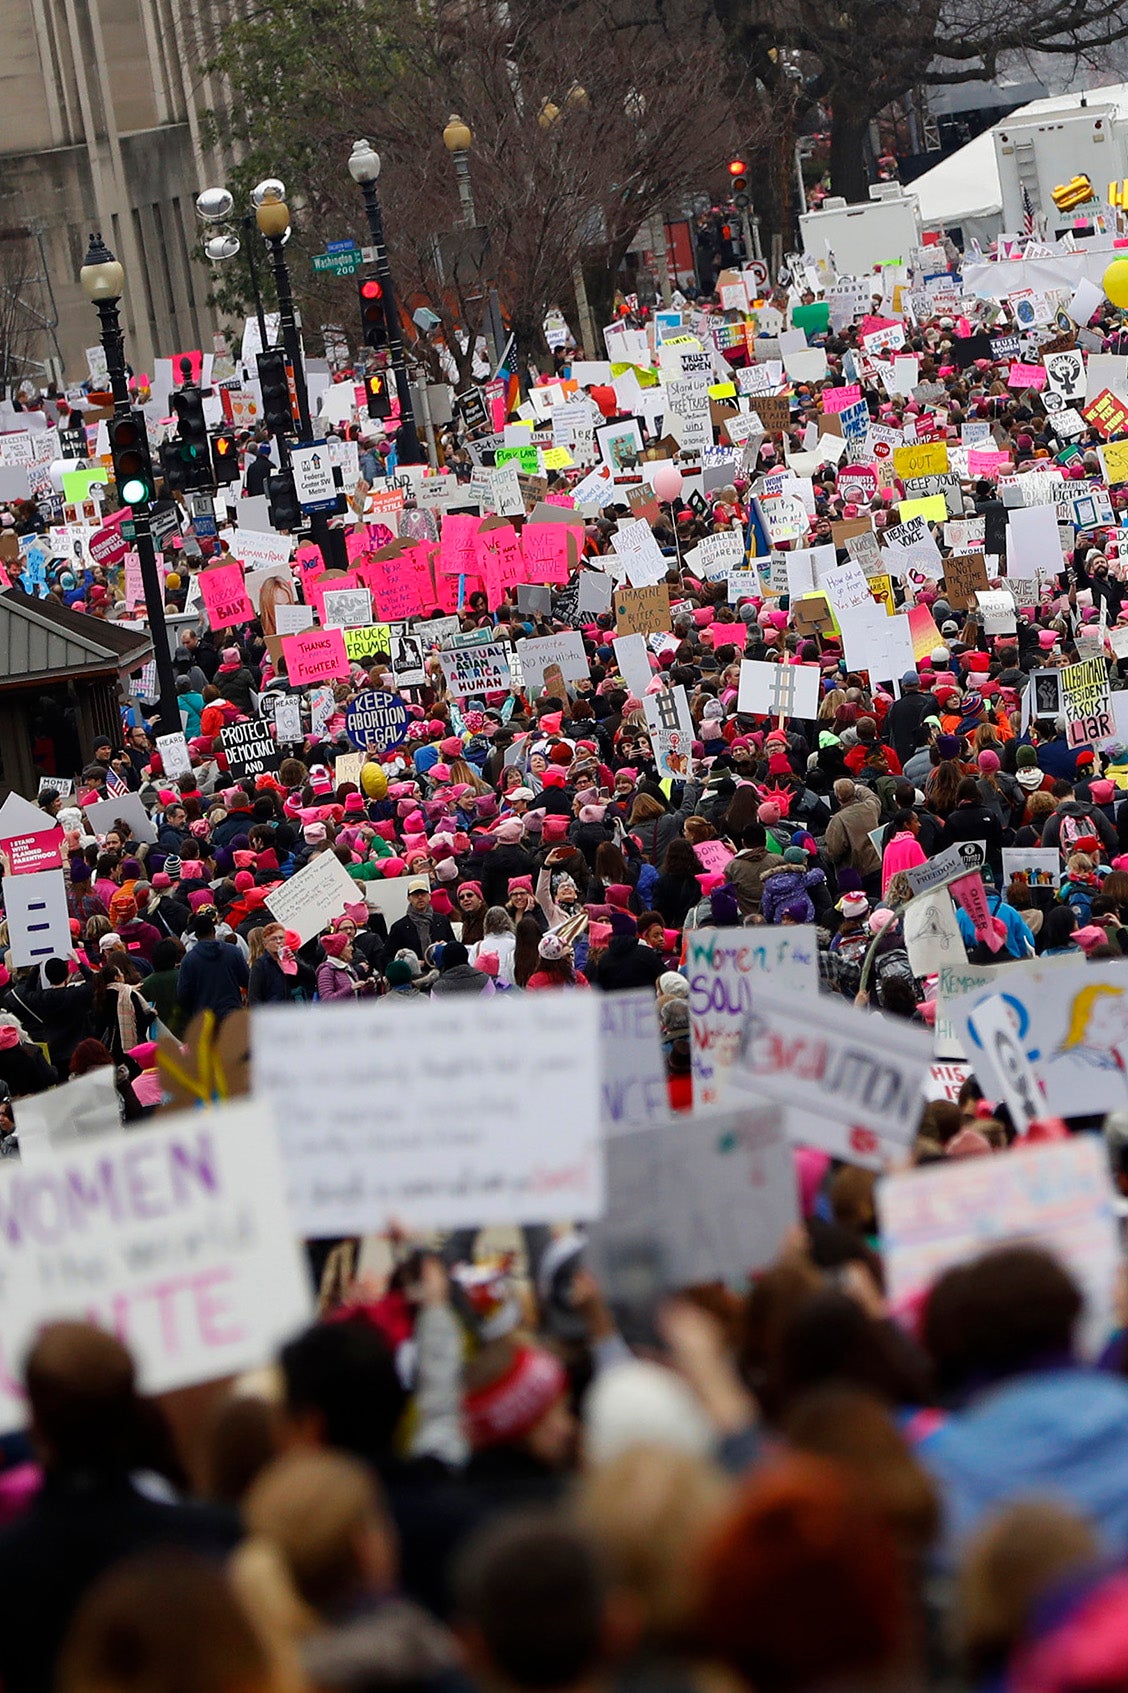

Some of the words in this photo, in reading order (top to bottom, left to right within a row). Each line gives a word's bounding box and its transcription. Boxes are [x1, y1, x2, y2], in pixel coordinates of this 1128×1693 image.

[314, 254, 353, 268] Washington
[337, 266, 354, 275] 200
[681, 353, 710, 363] TRUST
[682, 362, 712, 372] WOMEN
[670, 381, 692, 395] Stand
[870, 422, 892, 435] PROVE
[871, 433, 896, 444] WRONG
[875, 445, 890, 454] STOP
[909, 455, 933, 470] OUT
[491, 469, 516, 485] HOPE
[905, 478, 931, 491] KEEP
[935, 474, 960, 487] YOUR
[383, 503, 402, 512] STILL
[886, 523, 906, 542] HEAR
[906, 515, 925, 534] OUR
[92, 533, 119, 553] FEMINISTS
[898, 530, 924, 548] VOICE
[94, 548, 111, 562] FIGHT
[110, 539, 126, 555] BACK
[947, 560, 963, 569] NOW
[956, 565, 974, 574] NOT
[826, 575, 843, 589] How
[949, 574, 962, 584] THE
[965, 572, 982, 582] TIME
[621, 587, 660, 602] IMAGINE
[1009, 578, 1033, 597] WE
[215, 599, 246, 620] BABY
[347, 627, 387, 641] TRUCK
[297, 640, 332, 651] THANKS
[347, 639, 388, 658] FRUMP
[442, 647, 502, 663] BISEXUAL
[298, 657, 340, 676] FIGHTER!
[456, 659, 489, 670] ASIAN
[522, 659, 536, 668] NO
[450, 666, 509, 681] AMERICAN
[1061, 663, 1109, 692] ILLEGITIMATE
[458, 678, 502, 692] HUMAN
[355, 691, 394, 712] KEEP
[1062, 683, 1109, 706] PRESIDENT
[275, 698, 298, 707] HEARD
[1066, 698, 1109, 721] FASCIST
[348, 706, 407, 730] ABORTION
[220, 719, 270, 746] PROTECT
[356, 729, 404, 747] LEGAL
[159, 736, 183, 747] HEARD
[245, 760, 264, 775] AND
[15, 837, 35, 846] STAND
[12, 847, 42, 859] PLANNED
[14, 851, 57, 865] PARENTHOOD
[916, 859, 956, 885] FREEDOM
[970, 888, 988, 930] QUEER
[693, 935, 768, 973] Women
